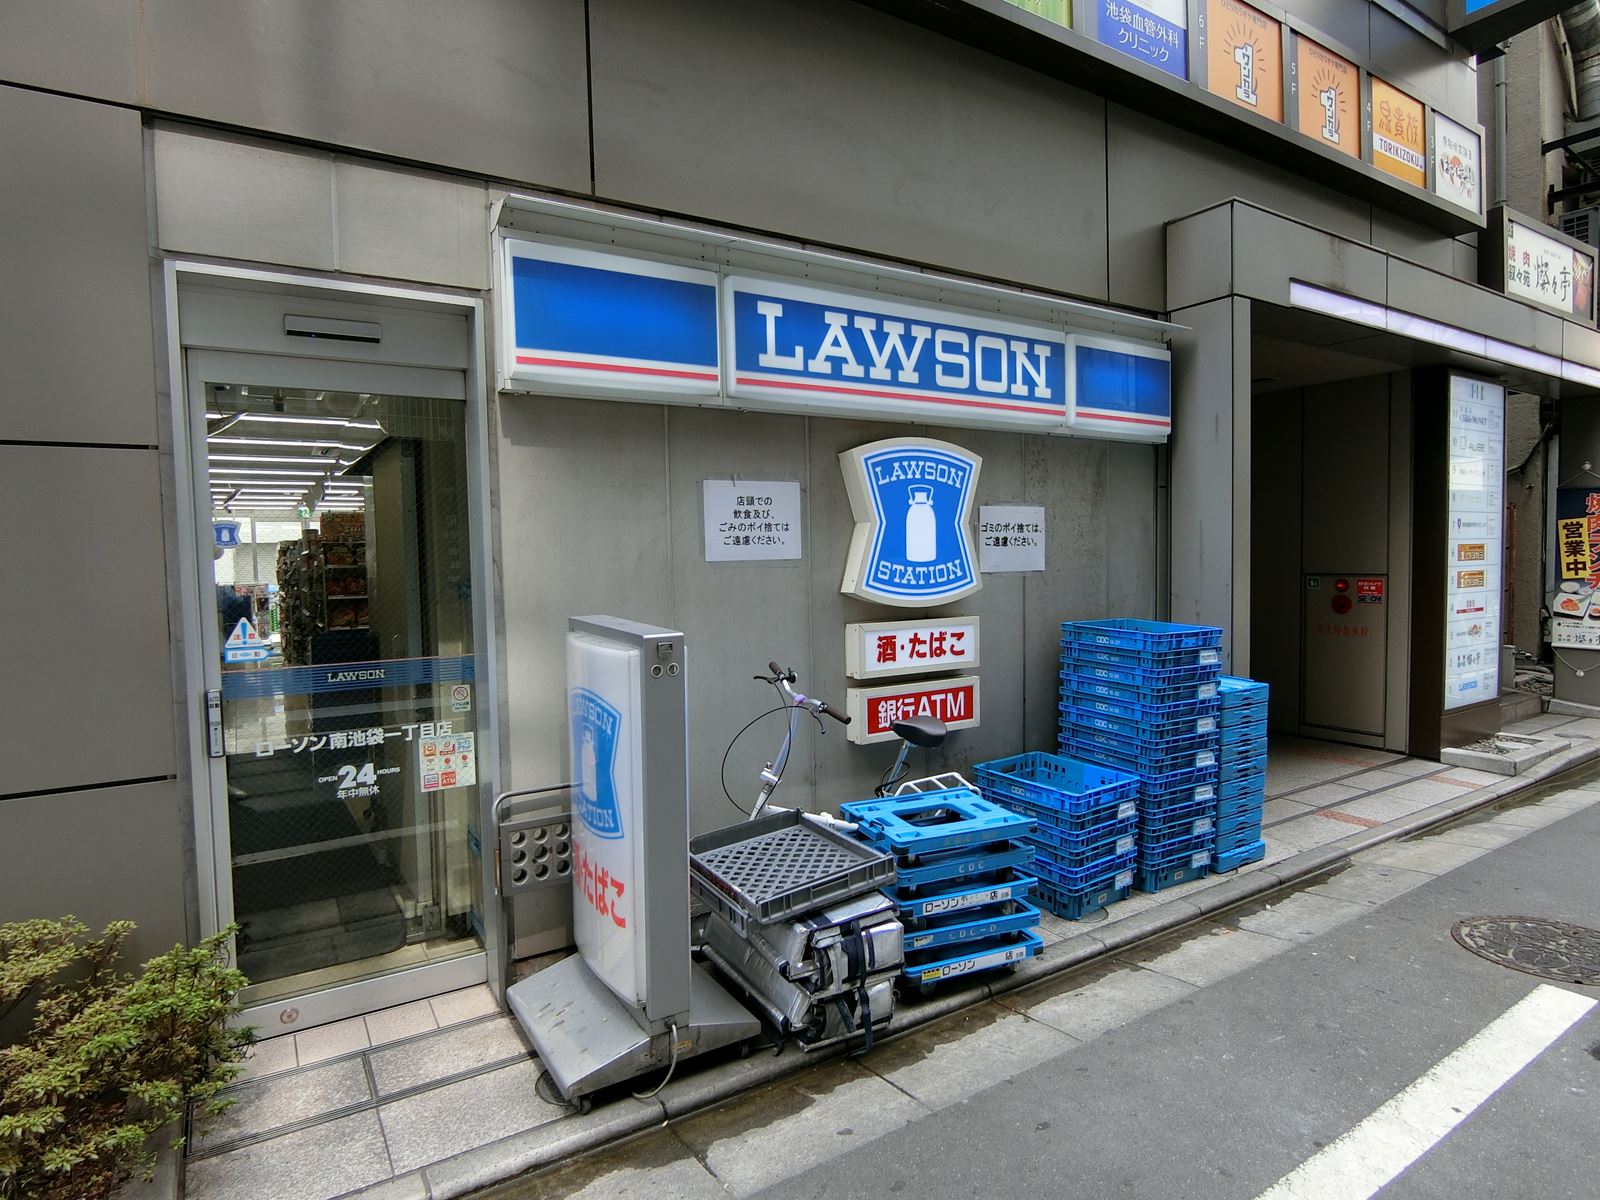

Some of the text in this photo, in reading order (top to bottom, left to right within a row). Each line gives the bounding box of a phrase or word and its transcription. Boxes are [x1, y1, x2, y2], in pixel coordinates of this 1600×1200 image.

[1106, 1, 1180, 49] 池袋血管外科
[1118, 28, 1169, 62] クリニック
[1379, 138, 1420, 167] TORIKIZOKU
[757, 300, 1052, 399] LAWSON
[875, 460, 964, 489] LAWSON
[733, 508, 775, 520] 飲食及び、
[736, 496, 773, 507] 店頭での
[719, 521, 790, 533] ごみのポイ捨ては
[980, 522, 1042, 534] ゴミのポイ捨ては、
[723, 535, 786, 547] ご遠慮ください。
[984, 535, 1039, 548] ご遠慮ください。
[1563, 521, 1587, 576] 営業中
[877, 559, 963, 585] STATION
[876, 631, 965, 662] 酒・たばこ
[327, 669, 386, 682] LAWSON
[878, 691, 965, 729] 銀行ATM
[256, 720, 453, 757] ローソン南池袋一丁目店
[318, 763, 400, 789] OPEN 24 HOURS
[336, 785, 380, 799] 年中無休
[925, 897, 959, 913] ローソン
[942, 960, 976, 976] ローソン
